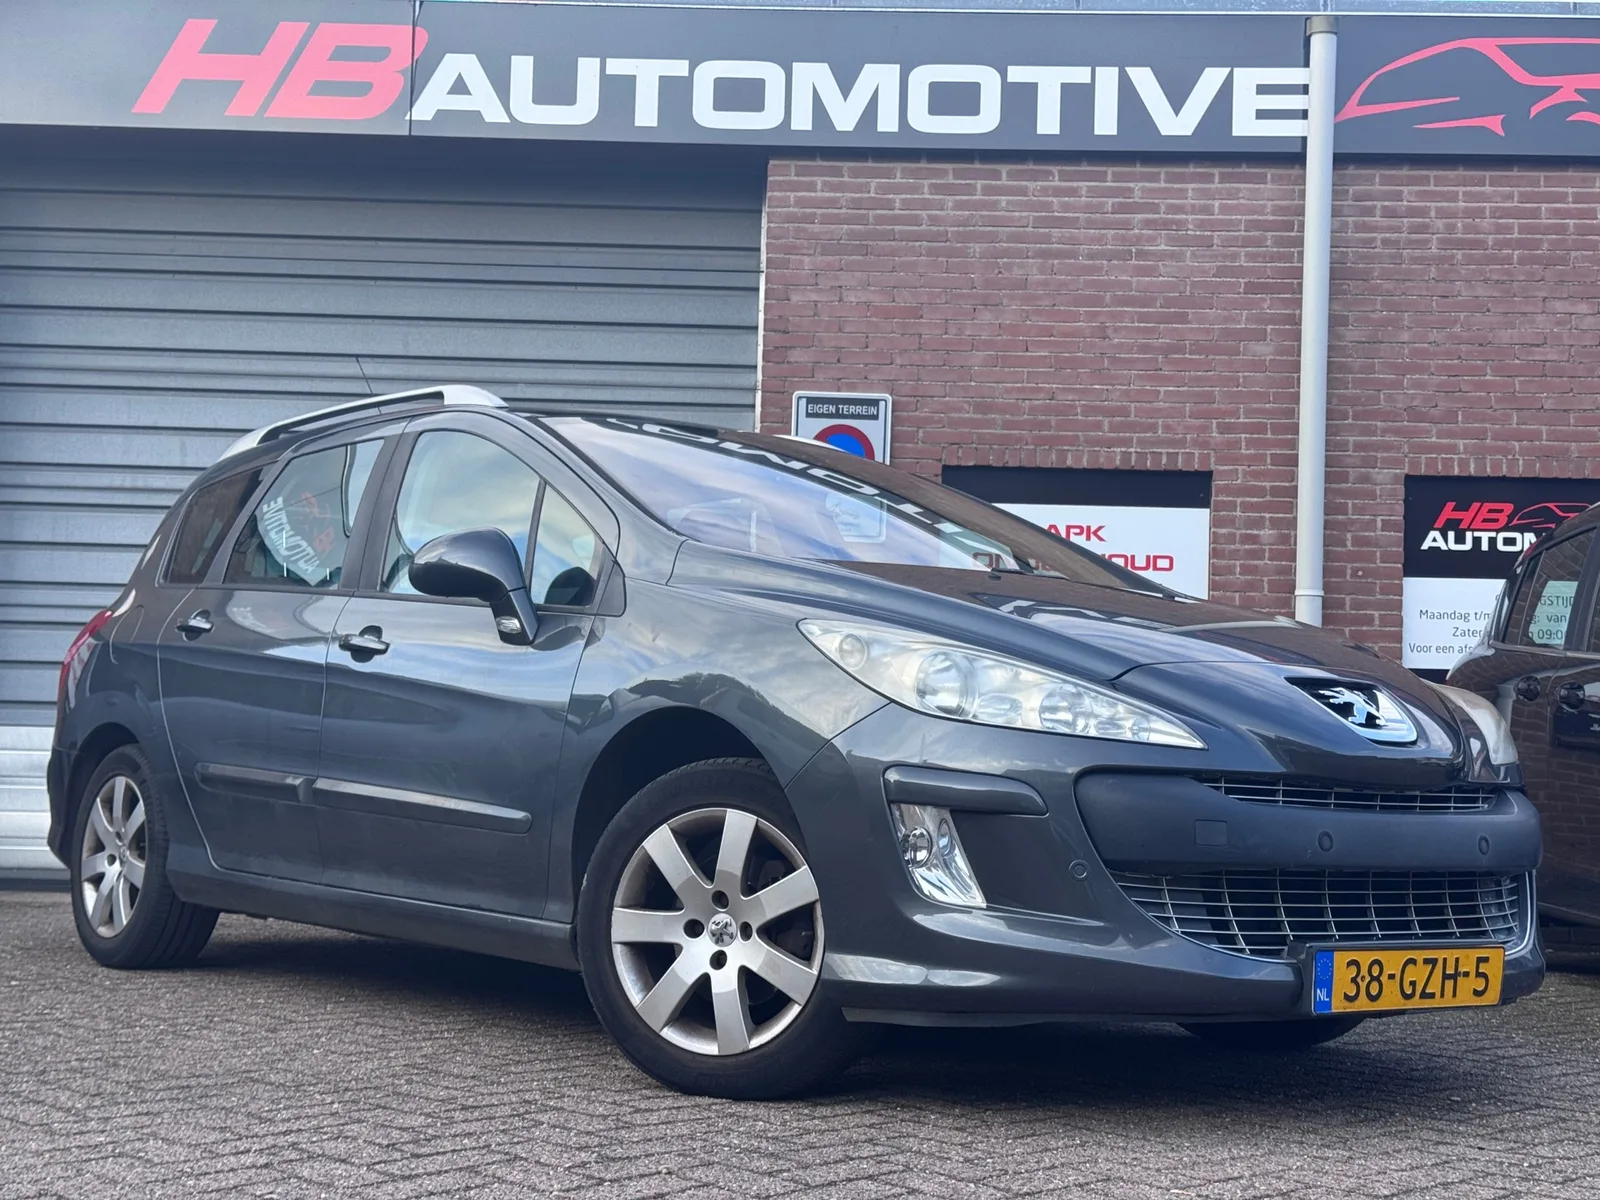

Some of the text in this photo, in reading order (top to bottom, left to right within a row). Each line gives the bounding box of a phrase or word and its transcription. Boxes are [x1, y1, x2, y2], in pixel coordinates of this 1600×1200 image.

[131, 18, 1309, 137] HB AUTOMOTIVE
[807, 404, 878, 415] EIGEN TERREIN
[1433, 501, 1515, 530] HB
[1419, 609, 1470, 623] Maandag
[1546, 614, 1567, 623] van
[1452, 627, 1483, 638] Zater
[1537, 629, 1564, 640] 09:0
[1408, 642, 1432, 653] Voor
[1435, 645, 1455, 654] een
[1343, 956, 1490, 1003] 38-GZH-5
[1316, 988, 1330, 1002] NL
